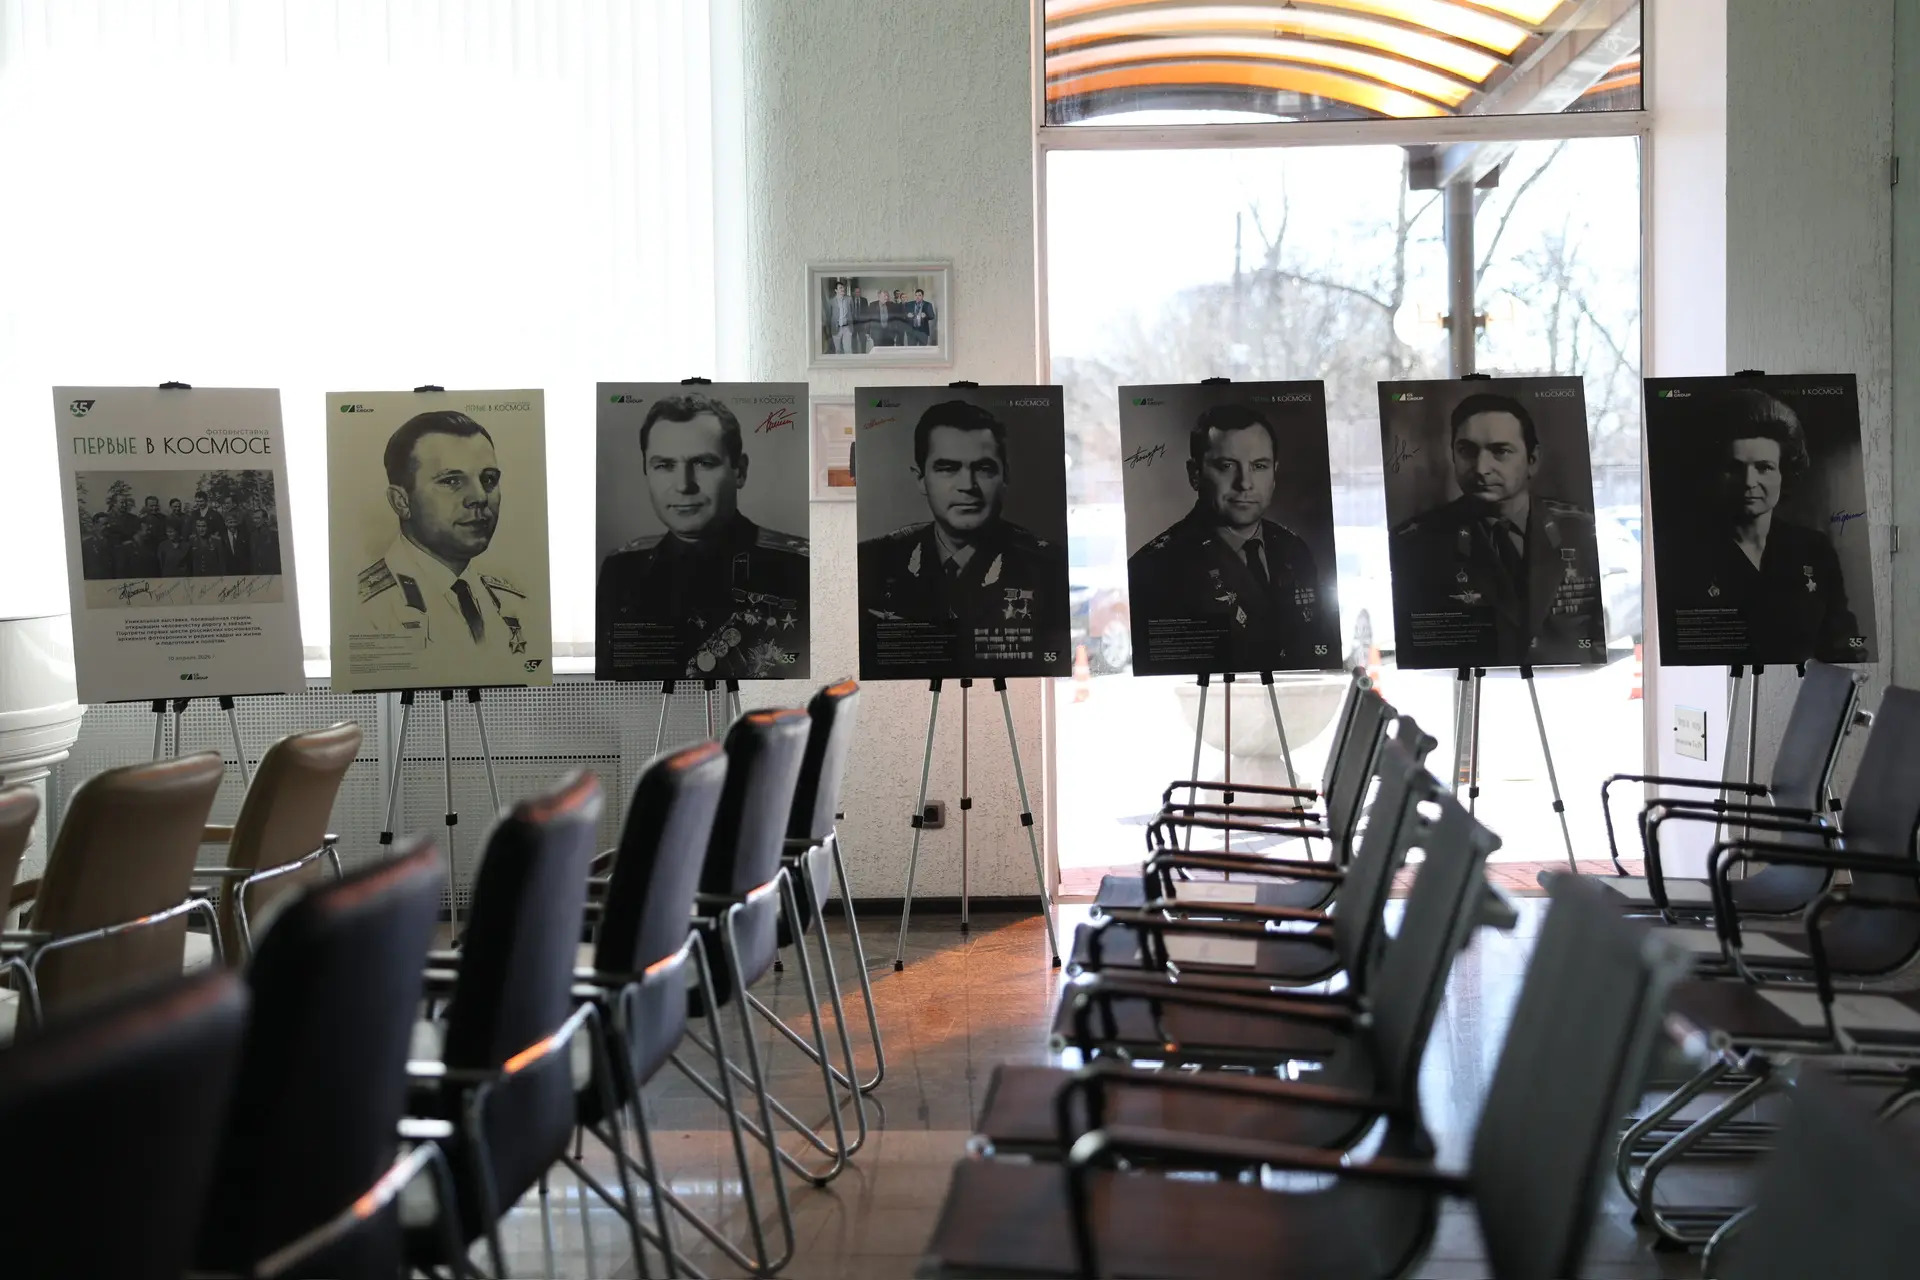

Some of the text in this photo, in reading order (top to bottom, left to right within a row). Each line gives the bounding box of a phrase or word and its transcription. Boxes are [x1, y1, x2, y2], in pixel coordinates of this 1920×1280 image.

[205, 427, 269, 437] фотовыставка
[73, 437, 272, 455] ПЕРВЫЕ В КОСМОСЕ
[1578, 639, 1591, 649] 35
[1849, 637, 1863, 647] 35
[1314, 645, 1328, 655] 35
[782, 654, 796, 664] 35
[1043, 652, 1057, 662] 35
